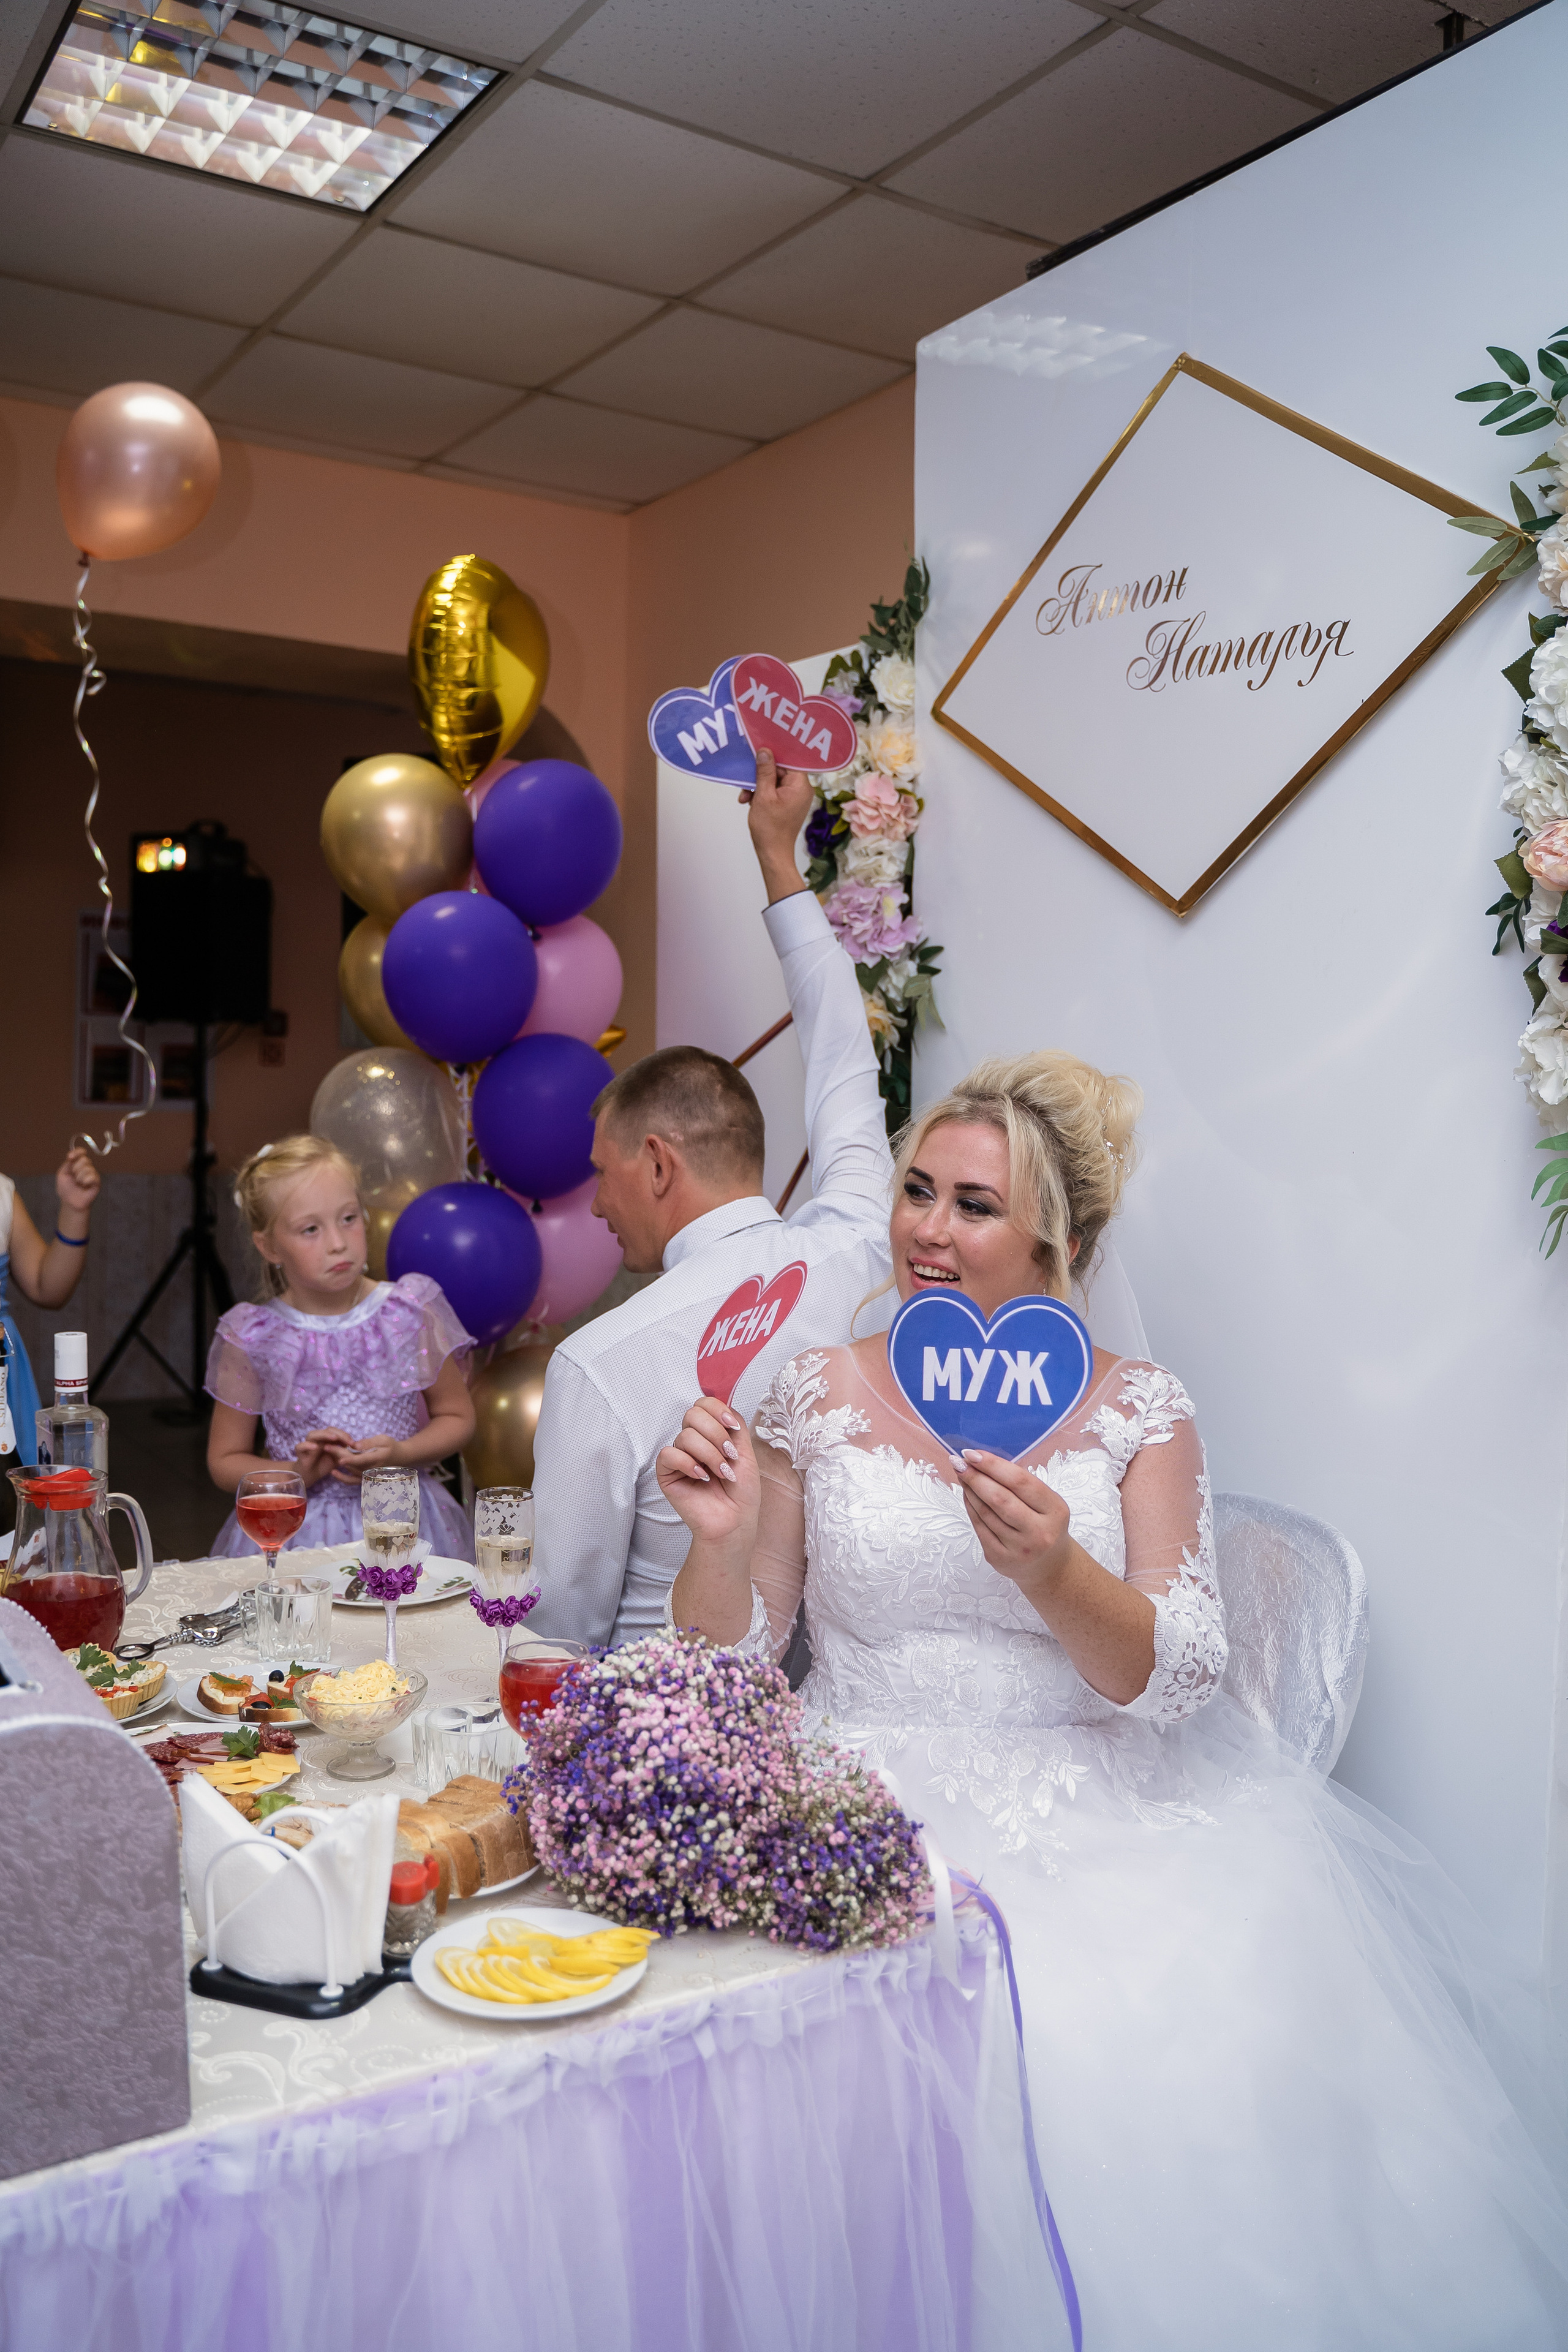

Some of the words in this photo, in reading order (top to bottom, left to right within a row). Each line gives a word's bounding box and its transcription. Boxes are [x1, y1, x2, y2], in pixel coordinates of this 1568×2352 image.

[1036, 564, 1189, 636] Антон
[1126, 611, 1354, 693] Наталья
[737, 676, 832, 763] ЖЕНА
[698, 1298, 782, 1360] ЖЕНА
[922, 1346, 1052, 1405] МУЖ
